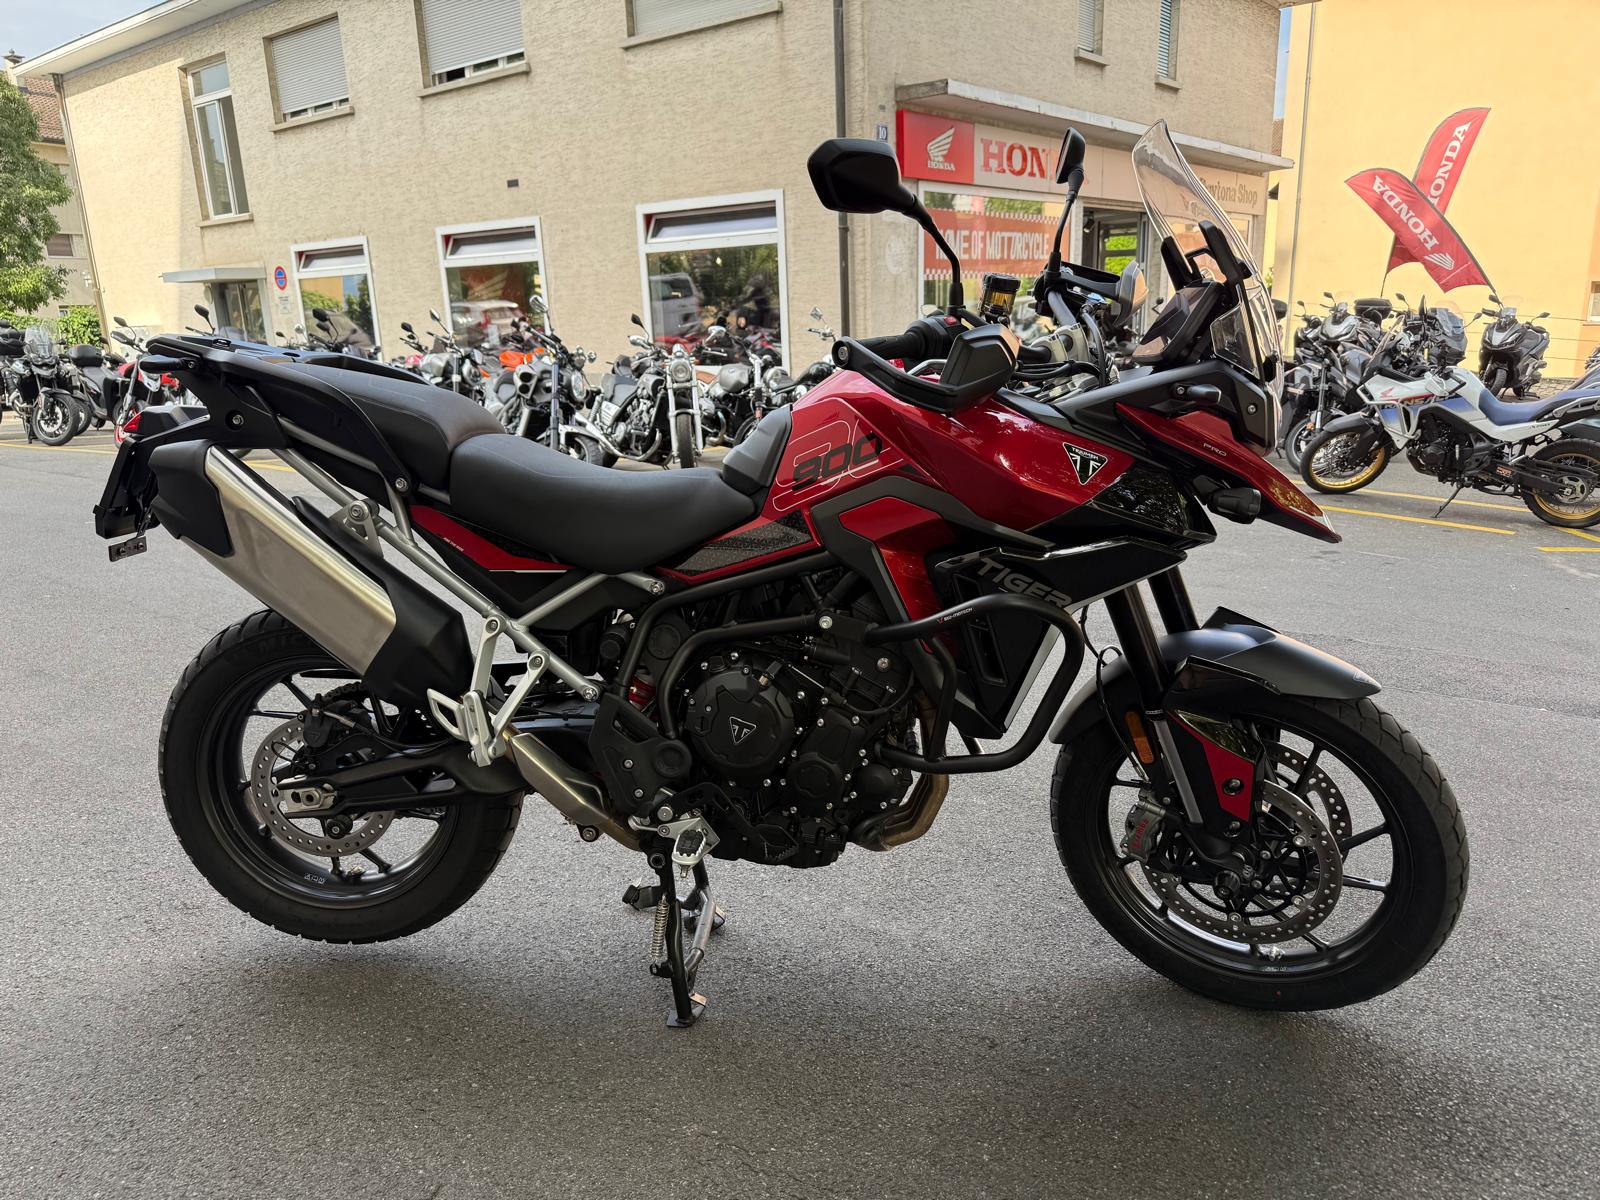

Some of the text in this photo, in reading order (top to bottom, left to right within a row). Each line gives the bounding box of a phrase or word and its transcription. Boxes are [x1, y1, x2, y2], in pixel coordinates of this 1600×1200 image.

[927, 160, 956, 172] HONDA
[1237, 183, 1258, 208] Shop
[1372, 174, 1439, 250] HONDA
[971, 230, 985, 260] OF
[791, 431, 884, 491] 900
[1203, 442, 1228, 457] PRO
[977, 557, 1073, 609] TIGER
